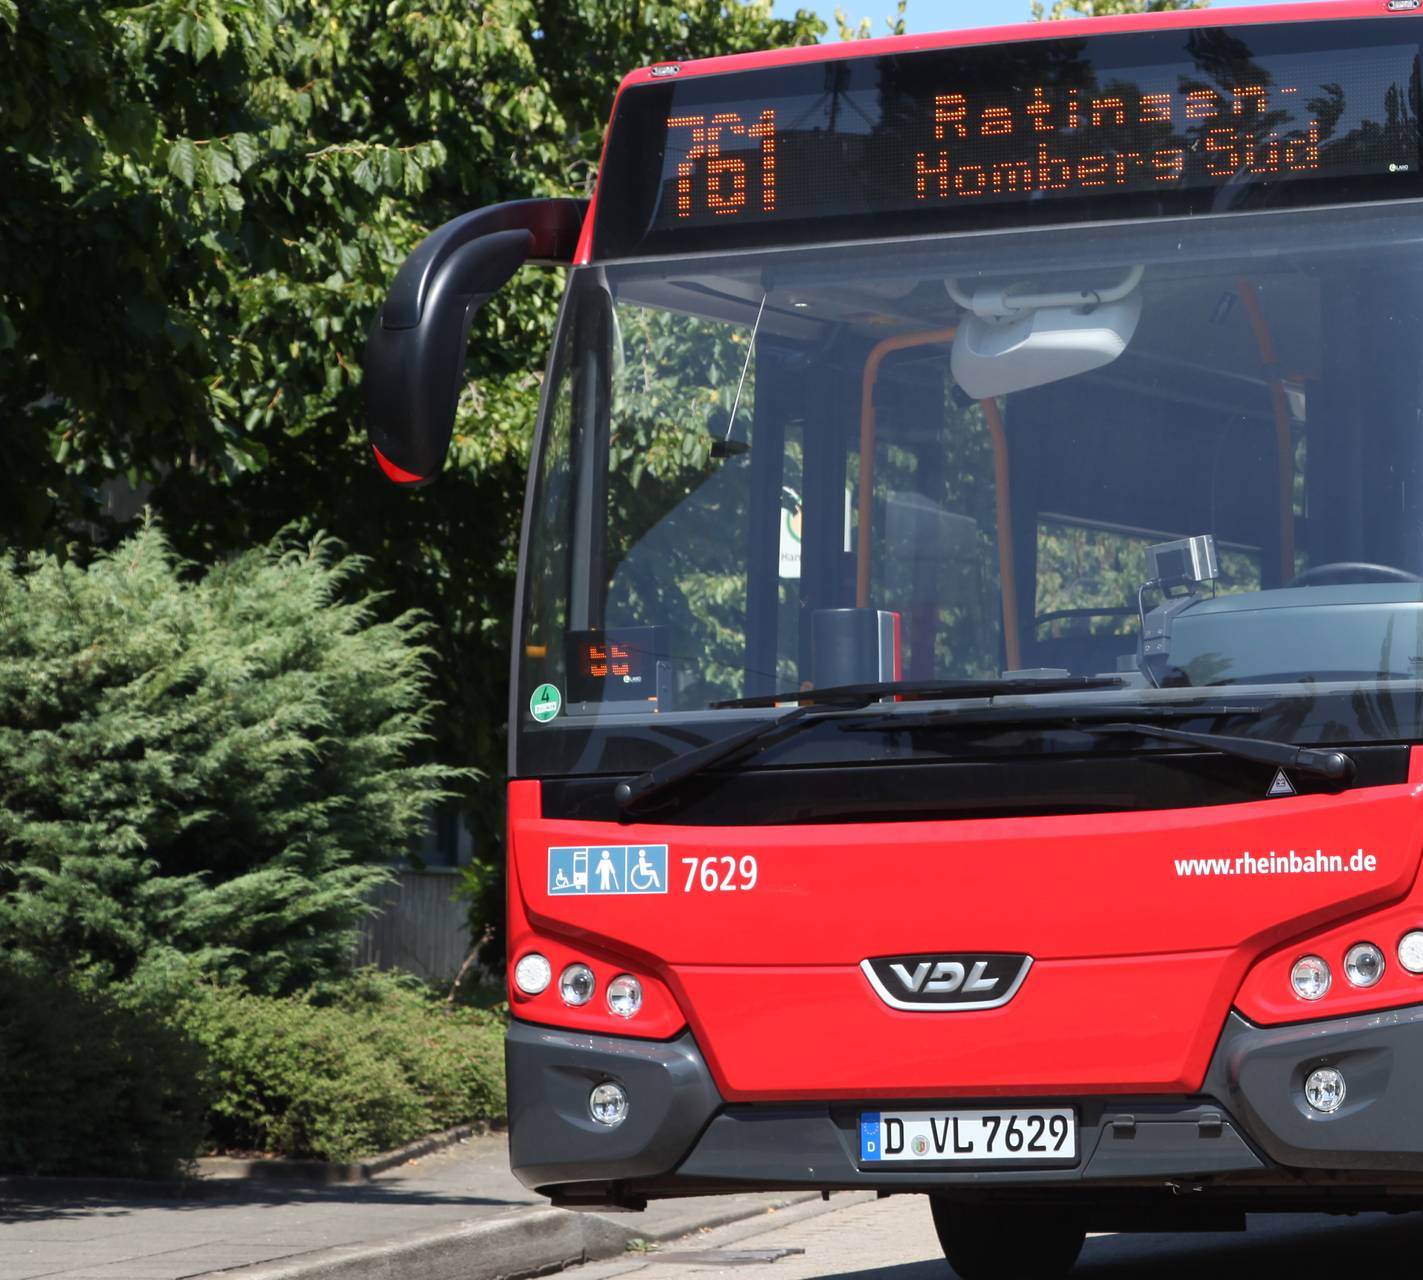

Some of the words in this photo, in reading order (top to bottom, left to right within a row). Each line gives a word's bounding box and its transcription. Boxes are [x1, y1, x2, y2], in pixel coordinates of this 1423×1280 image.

[666, 110, 774, 217] 761
[916, 143, 1184, 199] Homberg
[1205, 121, 1319, 176] Süd
[541, 686, 550, 702] 4
[681, 855, 758, 893] 7629
[1174, 849, 1377, 876] www.rheinbahn.de
[888, 961, 1000, 993] VDL
[867, 1141, 876, 1152] D
[884, 1118, 905, 1154] D
[929, 1117, 974, 1153] VL
[982, 1114, 1069, 1153] 7629
